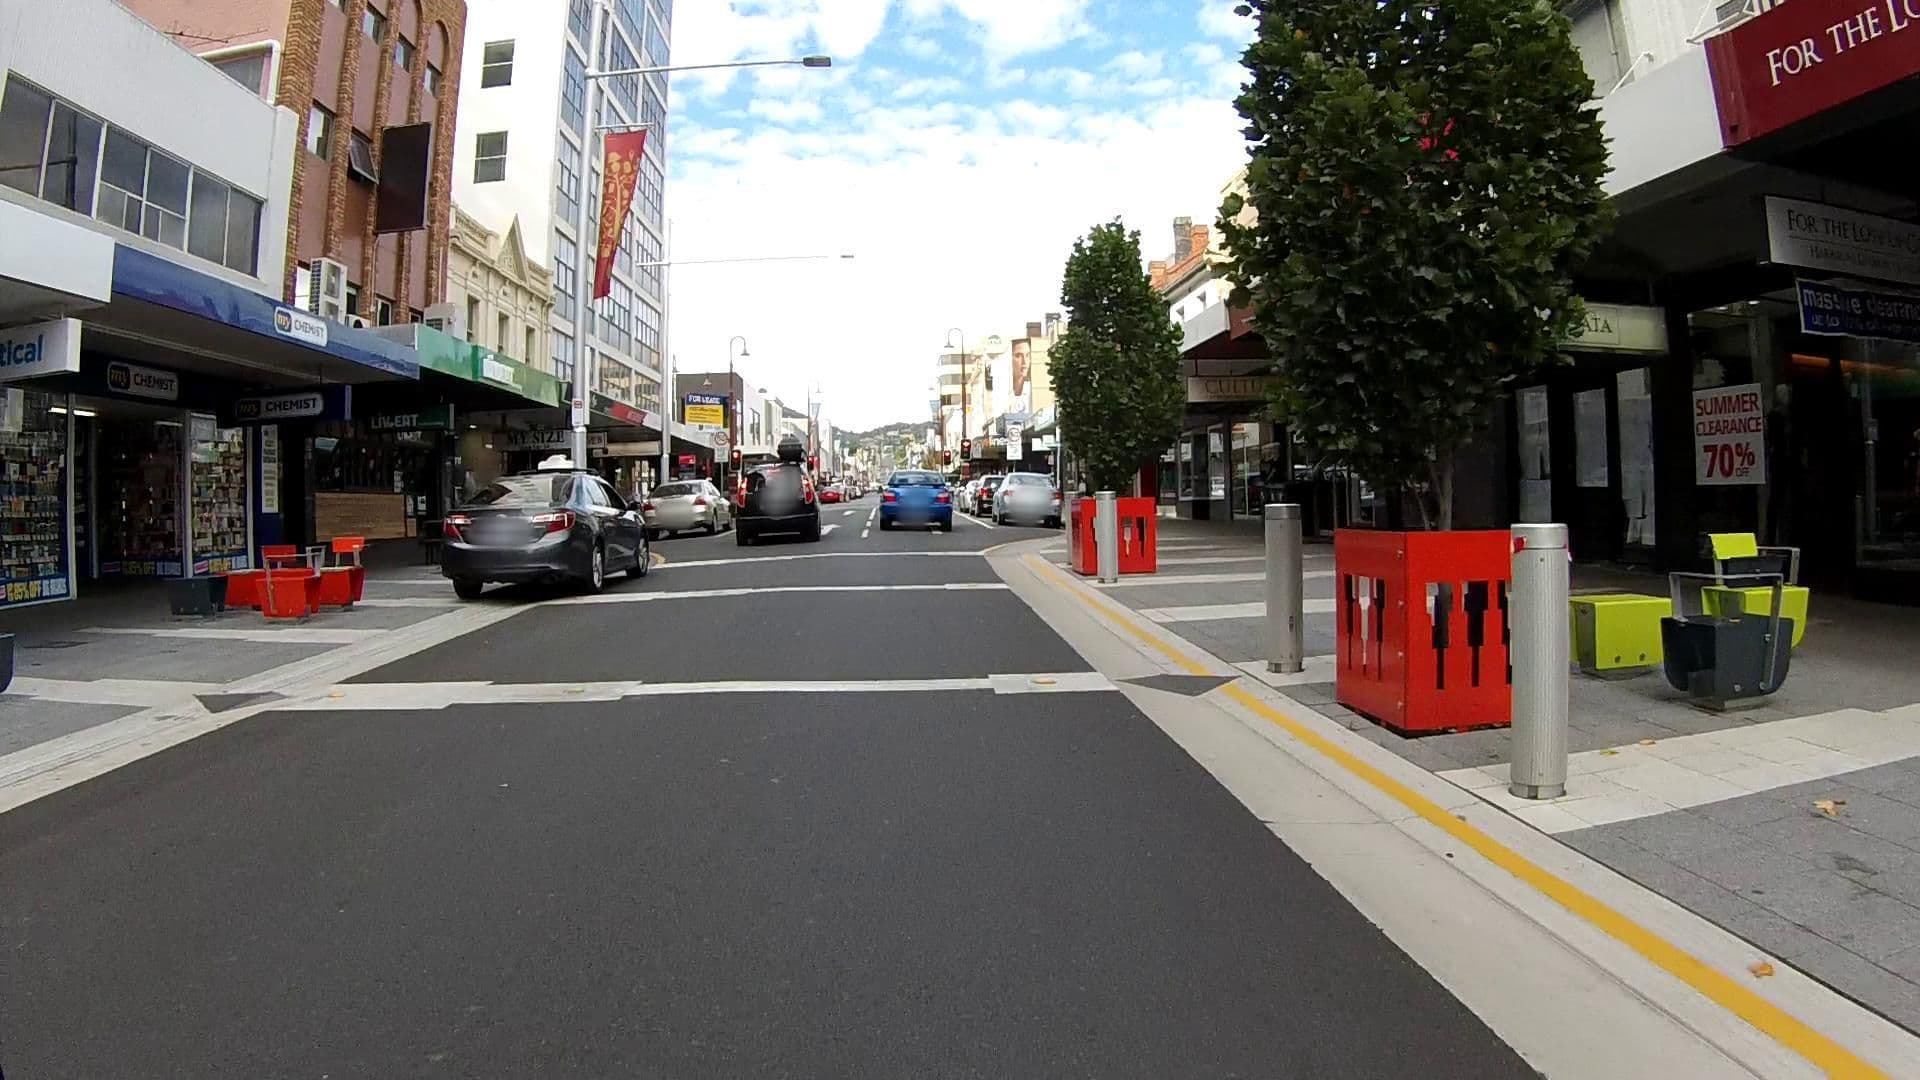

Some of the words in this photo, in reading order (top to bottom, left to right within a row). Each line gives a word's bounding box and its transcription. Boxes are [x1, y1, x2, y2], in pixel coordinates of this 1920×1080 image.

[1765, 37, 1824, 87] FOR
[1825, 6, 1883, 55] THE
[1787, 209, 1818, 233] FOR
[293, 319, 325, 338] CHEMIST
[133, 373, 175, 392] CHEMIST
[265, 398, 318, 412] CHEMIST
[688, 394, 702, 403] FOR
[702, 396, 722, 405] LEASE
[1696, 392, 1760, 416] SUMMER
[1696, 417, 1762, 436] CLEARANCE
[533, 429, 565, 444] SIZE
[1703, 443, 1756, 478] 70%
